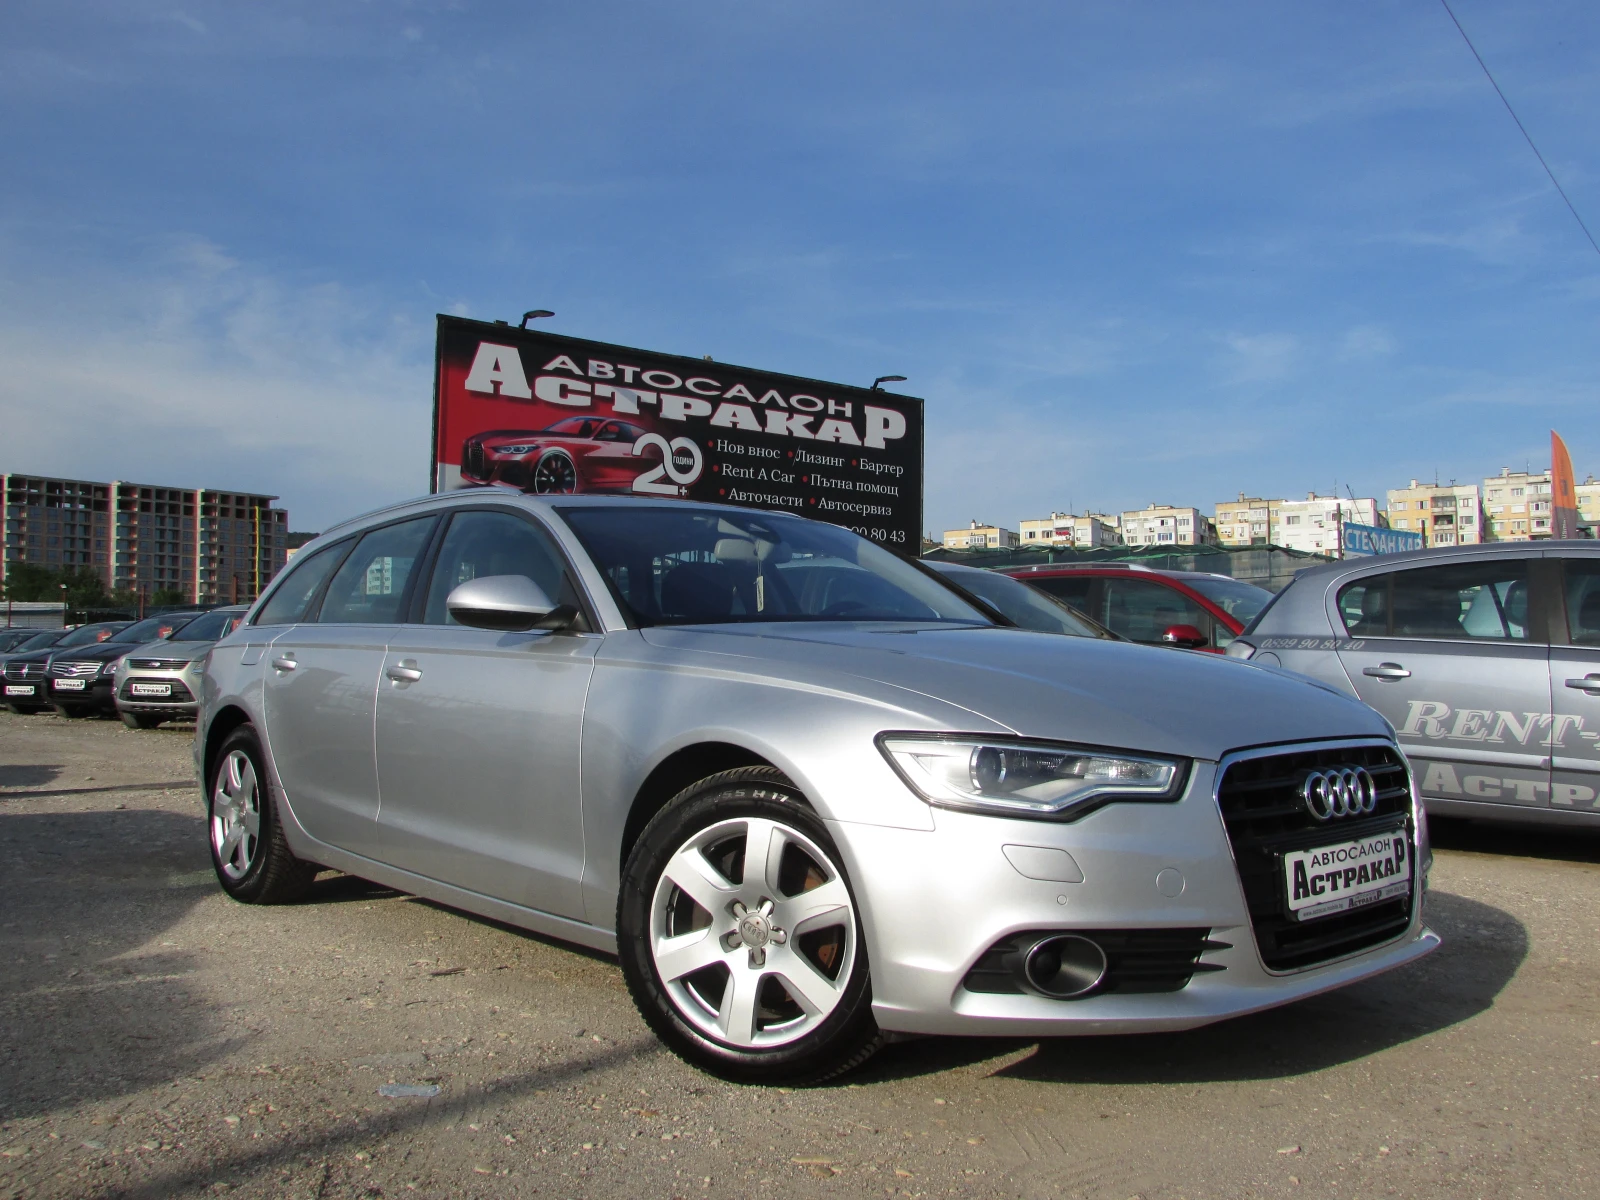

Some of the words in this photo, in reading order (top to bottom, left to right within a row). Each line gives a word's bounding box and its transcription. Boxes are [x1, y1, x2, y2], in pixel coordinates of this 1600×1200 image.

[542, 355, 852, 418] АВТОСАЛОН
[673, 455, 694, 466] ГОДИНИ
[716, 439, 745, 454] Нов
[748, 445, 781, 459] внос
[796, 450, 846, 467] Лизинг
[859, 458, 904, 477] Бартер
[721, 463, 755, 479] Rent
[757, 468, 768, 481] A
[771, 469, 796, 484] Car
[810, 473, 853, 490] Пътна
[856, 482, 899, 498] помощ
[727, 488, 803, 507] Авточасти
[818, 497, 892, 517] Автосервиз
[870, 527, 887, 541] 80
[889, 530, 906, 543] 43
[1345, 528, 1396, 554] СТЕФАН
[1260, 638, 1298, 649] 0899
[1298, 639, 1320, 649] 90
[1320, 639, 1342, 650] 80
[1344, 640, 1365, 650] 40
[1422, 762, 1600, 808] АСТР
[1310, 838, 1391, 868] АВТОСАЛОН
